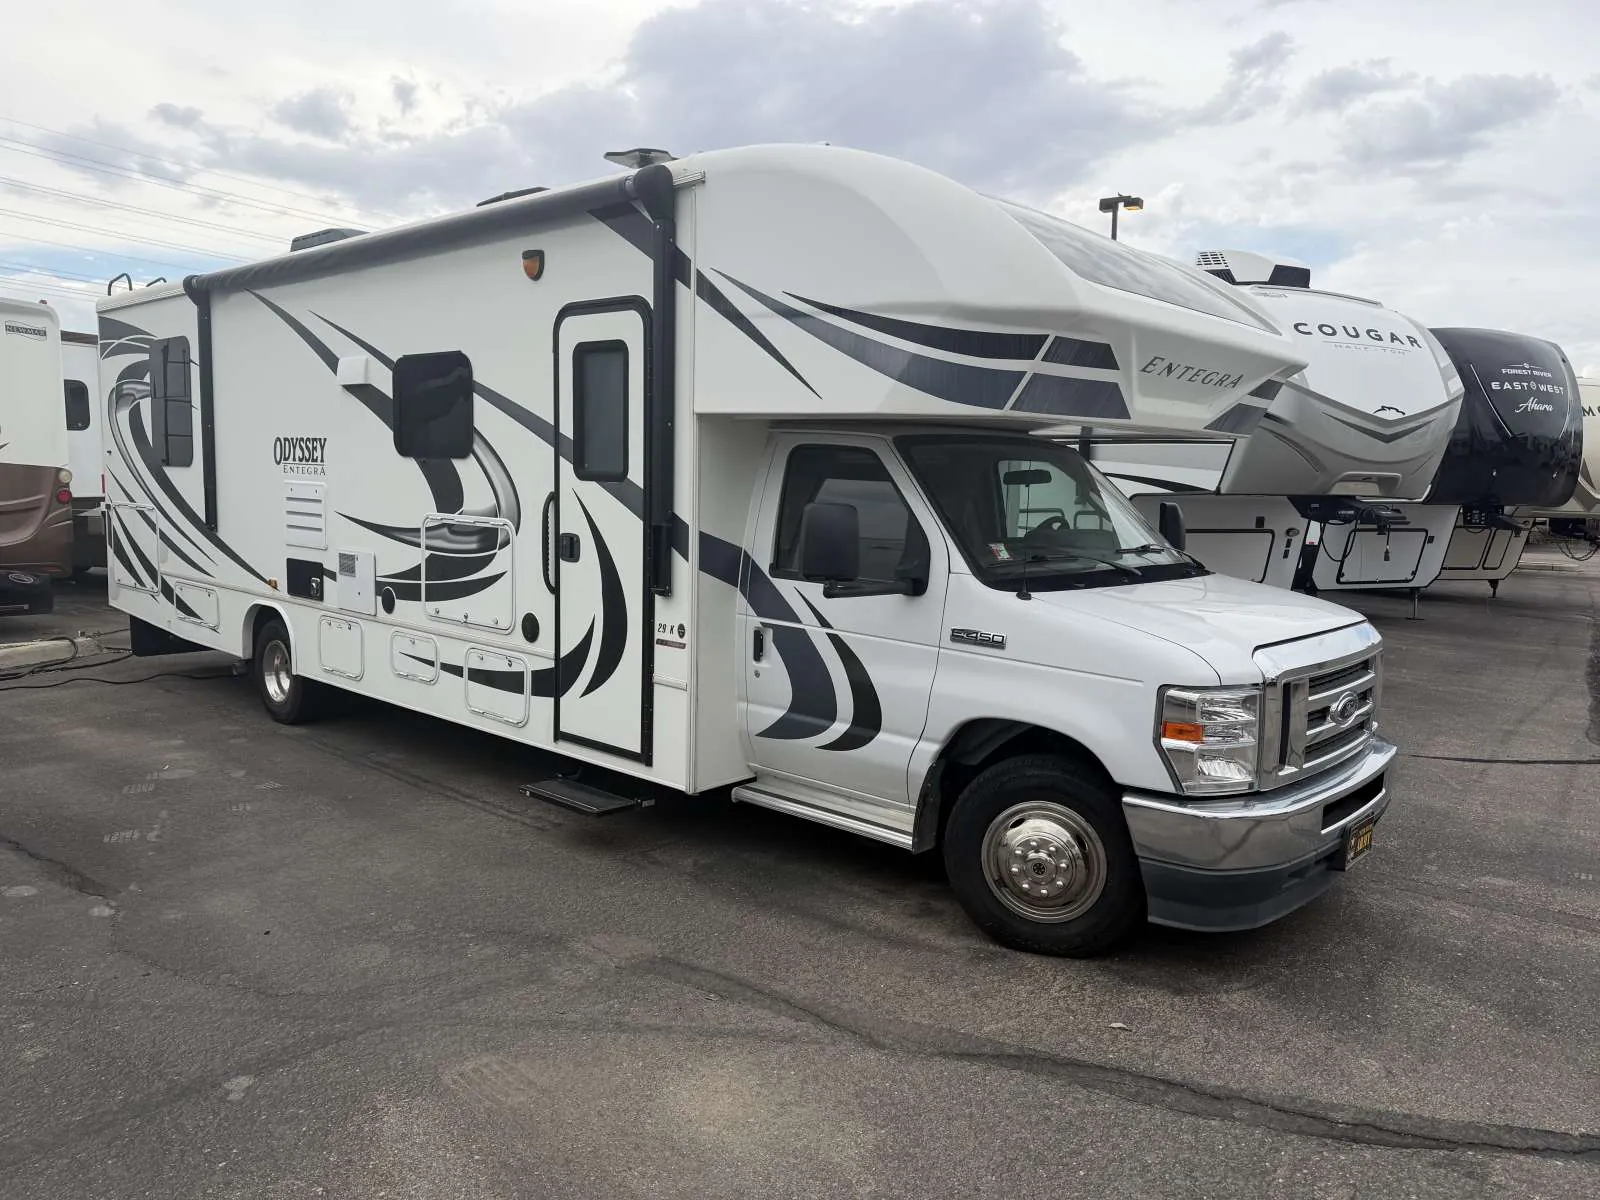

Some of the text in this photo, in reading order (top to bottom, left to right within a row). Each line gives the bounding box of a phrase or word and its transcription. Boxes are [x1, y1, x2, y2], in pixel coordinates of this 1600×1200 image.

[1293, 322, 1422, 349] COUGAR
[1139, 356, 1244, 389] ENTEGRA
[1532, 370, 1552, 378] RIVER
[1491, 381, 1564, 395] EAST WEST
[1515, 396, 1553, 413] Ahara
[1582, 405, 1600, 417] M
[273, 436, 327, 465] ODYSSEY
[283, 464, 326, 476] ENTEGRA
[657, 622, 667, 633] 29
